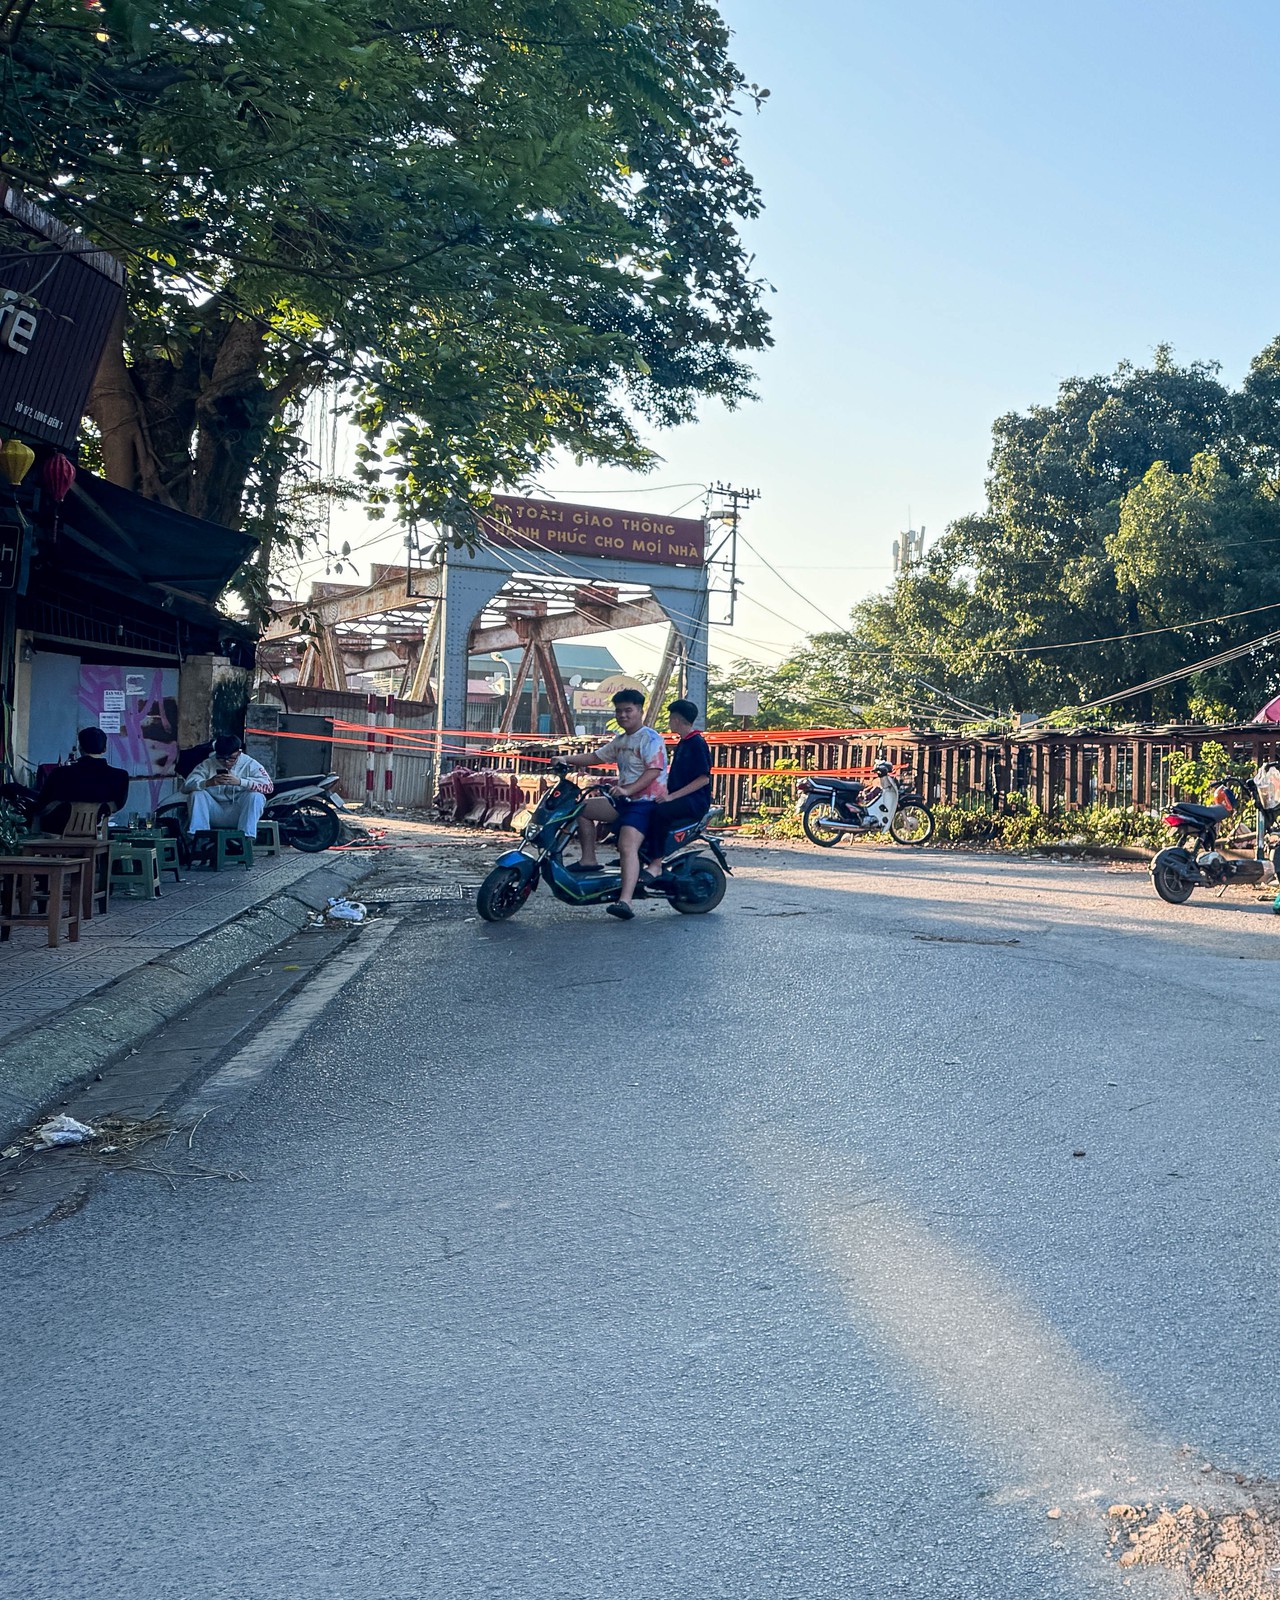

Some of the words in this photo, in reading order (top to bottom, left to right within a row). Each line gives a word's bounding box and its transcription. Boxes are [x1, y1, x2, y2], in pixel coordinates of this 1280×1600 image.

[516, 504, 563, 521] TOÀN
[572, 511, 613, 527] GIAO
[622, 517, 675, 535] THÔNG
[547, 527, 587, 544] PHÚC
[595, 536, 625, 549] CHO
[632, 540, 661, 555] MỌI
[668, 543, 699, 558] NHÀ
